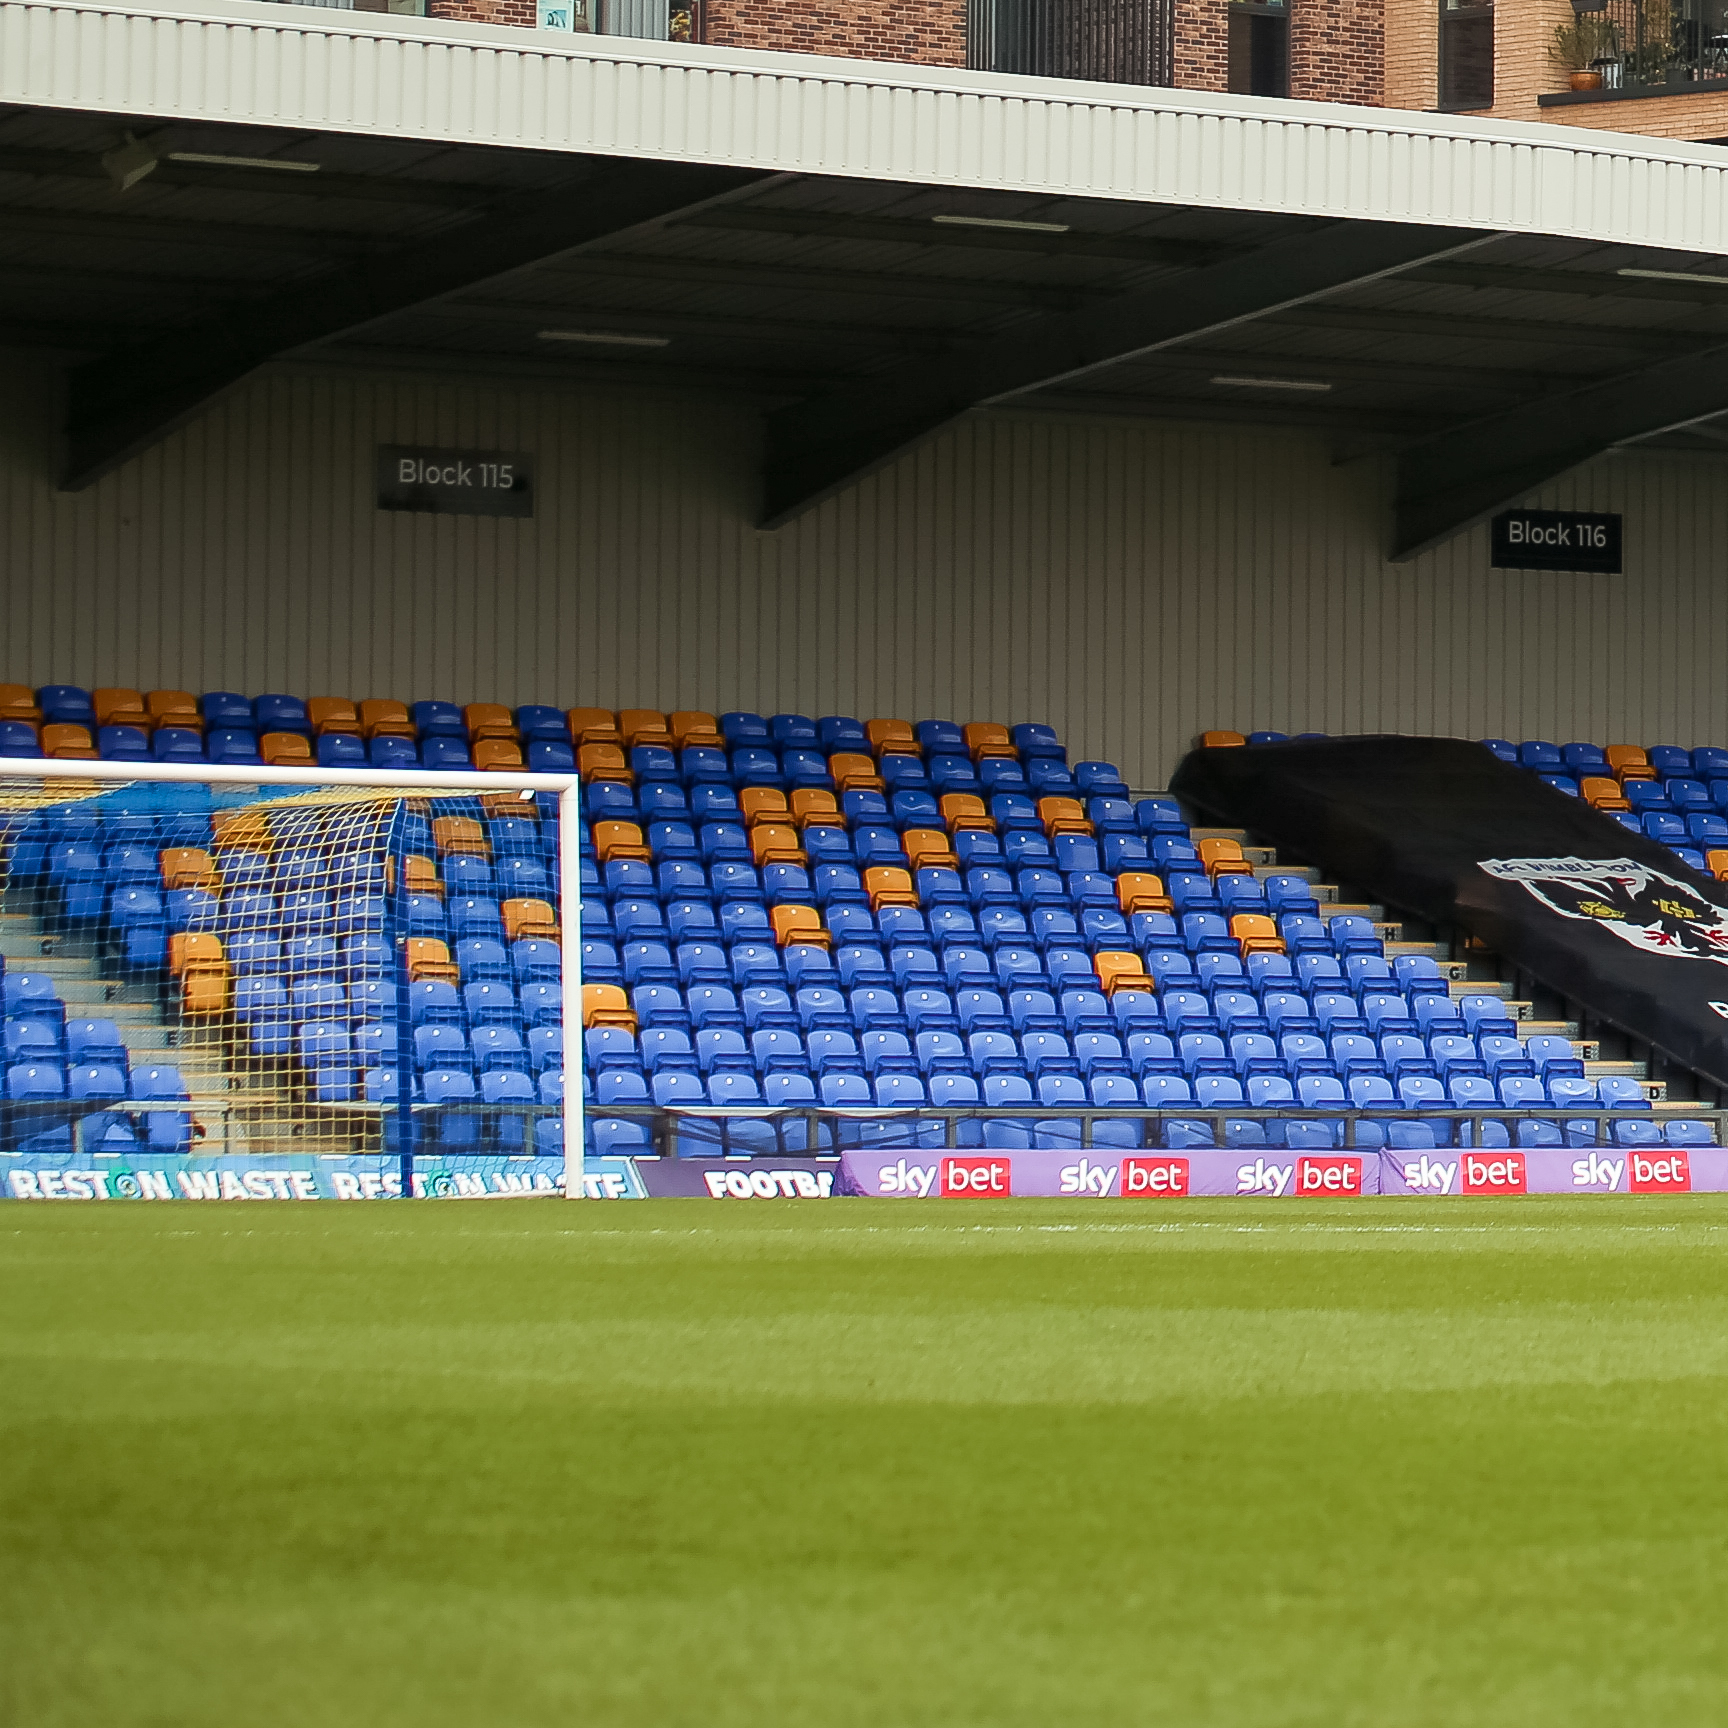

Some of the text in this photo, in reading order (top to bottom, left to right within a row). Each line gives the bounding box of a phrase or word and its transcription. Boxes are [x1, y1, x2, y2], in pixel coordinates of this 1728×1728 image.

[399, 459, 514, 489] Block 115
[1508, 521, 1607, 547] Block 116
[8, 1169, 321, 1200] RESTON WASTE
[878, 1158, 1003, 1199] sky bet
[1059, 1157, 1181, 1198] sky bet
[1237, 1157, 1355, 1197] sky bet
[1403, 1155, 1520, 1196] sky bet
[1571, 1151, 1684, 1192] sky bet
